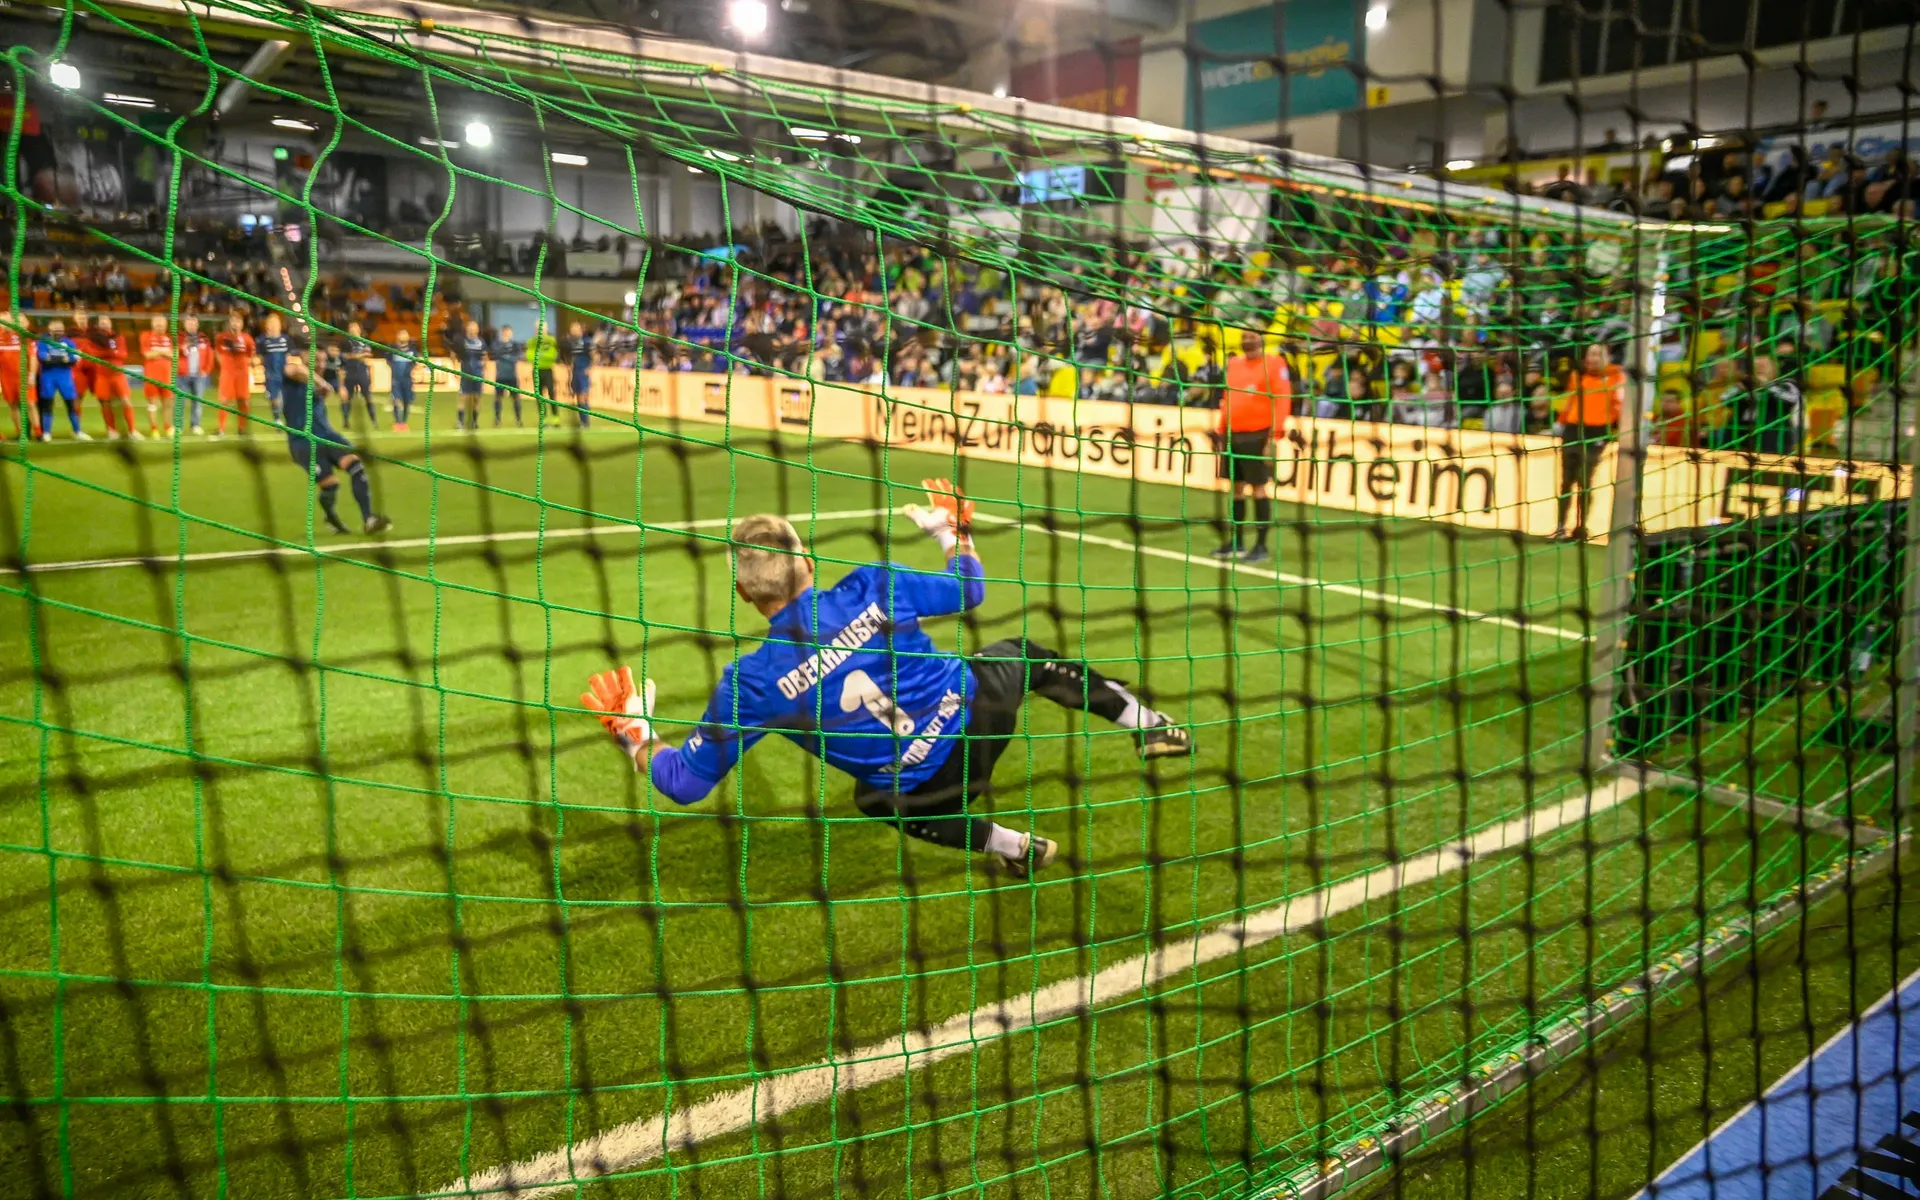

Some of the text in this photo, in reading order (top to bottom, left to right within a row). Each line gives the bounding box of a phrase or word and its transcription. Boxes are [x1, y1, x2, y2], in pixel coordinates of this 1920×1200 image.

[1200, 34, 1349, 90] westeergie
[875, 400, 945, 442] Mein
[961, 402, 1131, 465] Zuhause
[1153, 418, 1192, 474] in
[1216, 425, 1494, 514] ülheim
[776, 601, 888, 700] OBERHAUSEN
[840, 669, 915, 737] 1
